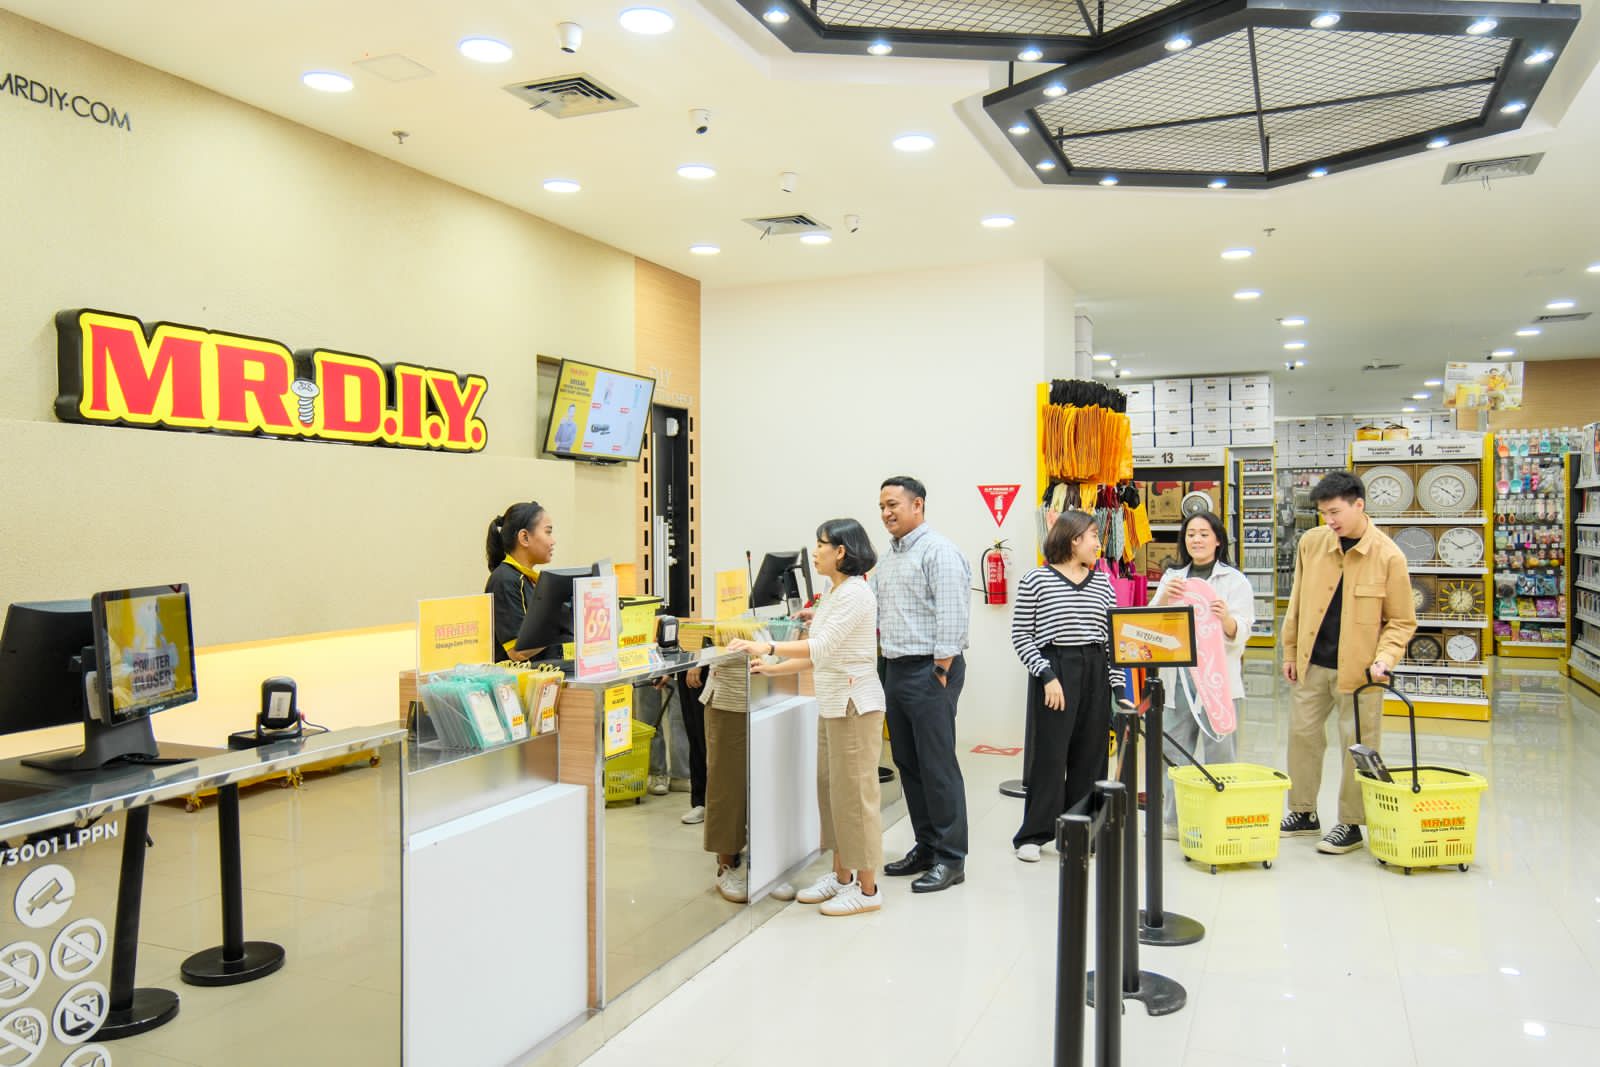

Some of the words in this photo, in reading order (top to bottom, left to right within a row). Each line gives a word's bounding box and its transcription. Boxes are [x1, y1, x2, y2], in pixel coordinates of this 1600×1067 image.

[1408, 444, 1423, 456] 14
[1161, 452, 1174, 464] 13
[66, 820, 119, 850] LPPN
